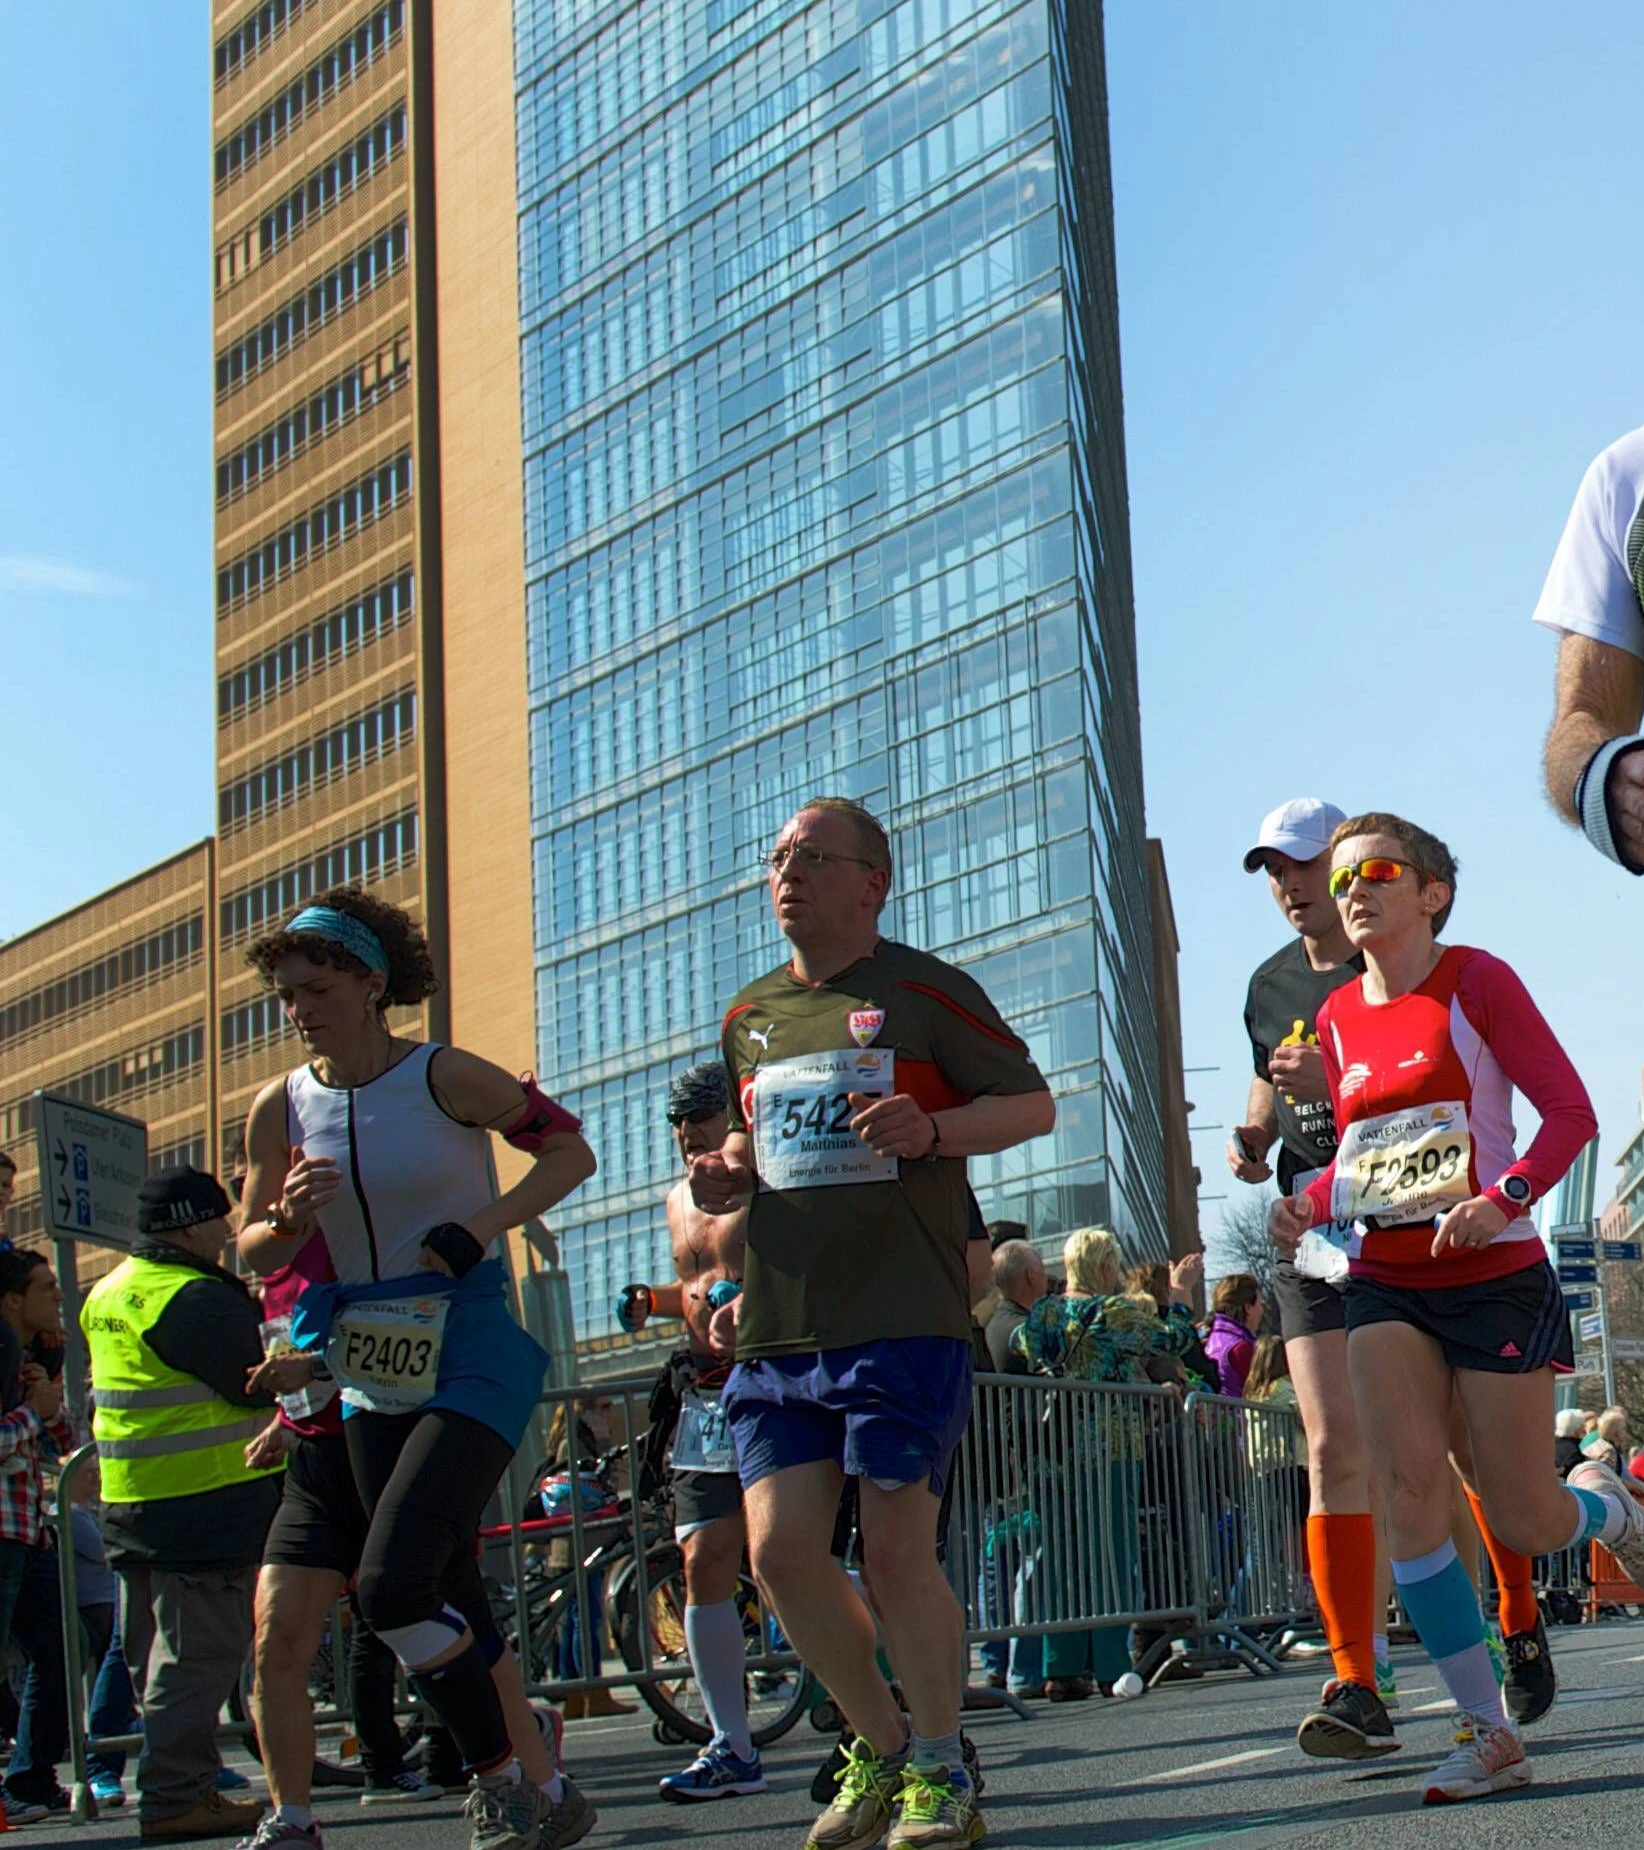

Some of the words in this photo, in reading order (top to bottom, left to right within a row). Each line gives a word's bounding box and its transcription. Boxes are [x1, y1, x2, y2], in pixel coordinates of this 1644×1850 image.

[783, 1061, 851, 1079] VATTENFALL
[773, 1094, 782, 1108] E
[781, 1092, 882, 1140] 542
[1357, 1119, 1428, 1143] VATTENFALL
[801, 1137, 857, 1153] Matthias
[789, 1166, 822, 1179] Energie
[824, 1164, 838, 1175] für
[842, 1162, 871, 1174] Berlin
[1360, 1144, 1462, 1199] F2593
[346, 1331, 433, 1377] F2403
